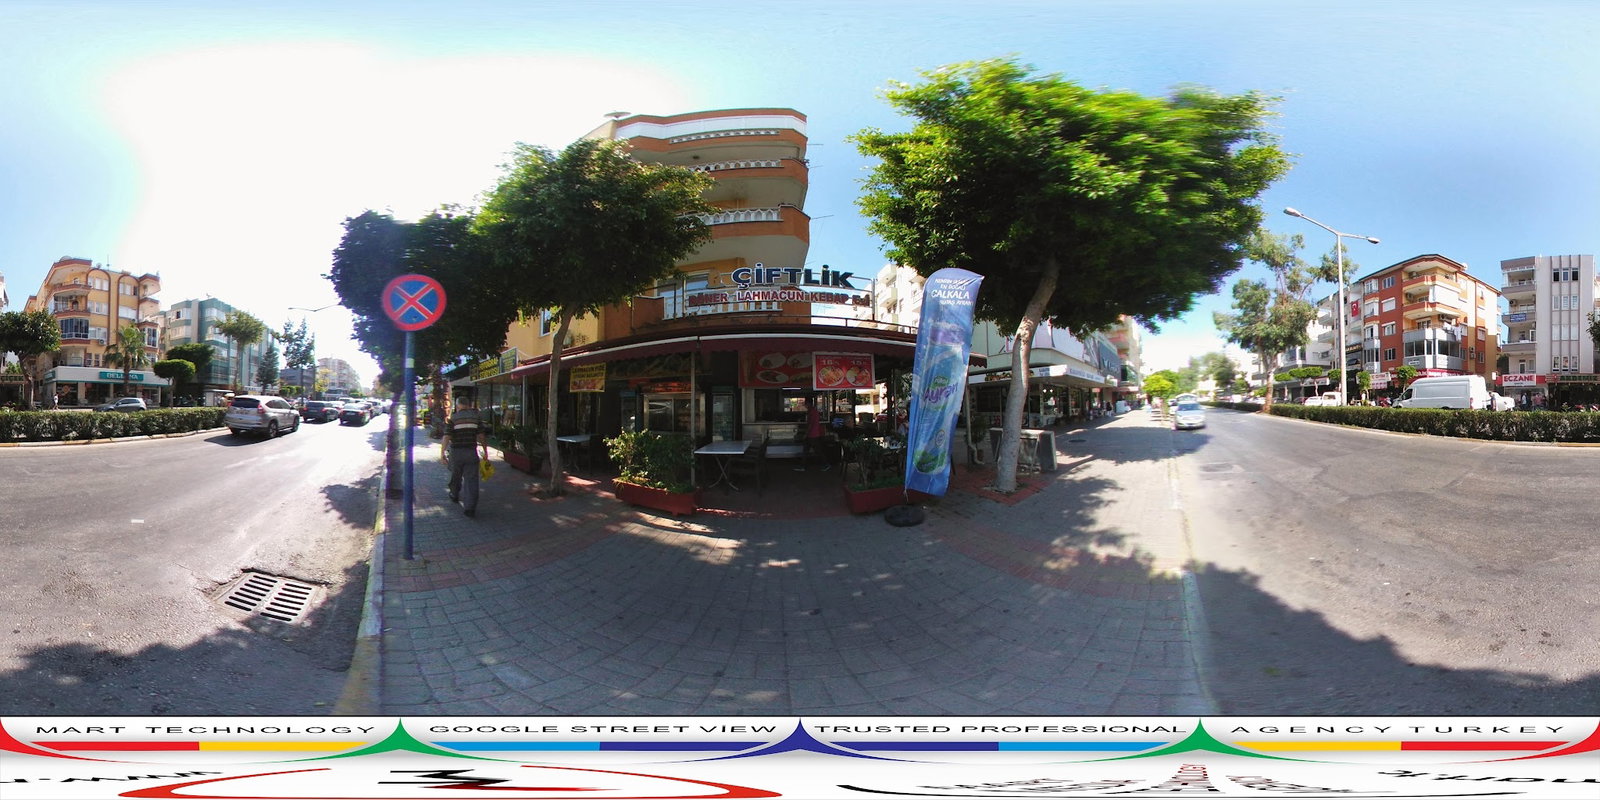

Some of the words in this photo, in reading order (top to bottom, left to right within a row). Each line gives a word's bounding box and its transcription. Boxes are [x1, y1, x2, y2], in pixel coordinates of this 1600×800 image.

[731, 262, 855, 290] ÇİFTLİK
[688, 292, 729, 307] DÖNER
[736, 289, 806, 303] LAHMACUN
[810, 292, 850, 305] KEBAP
